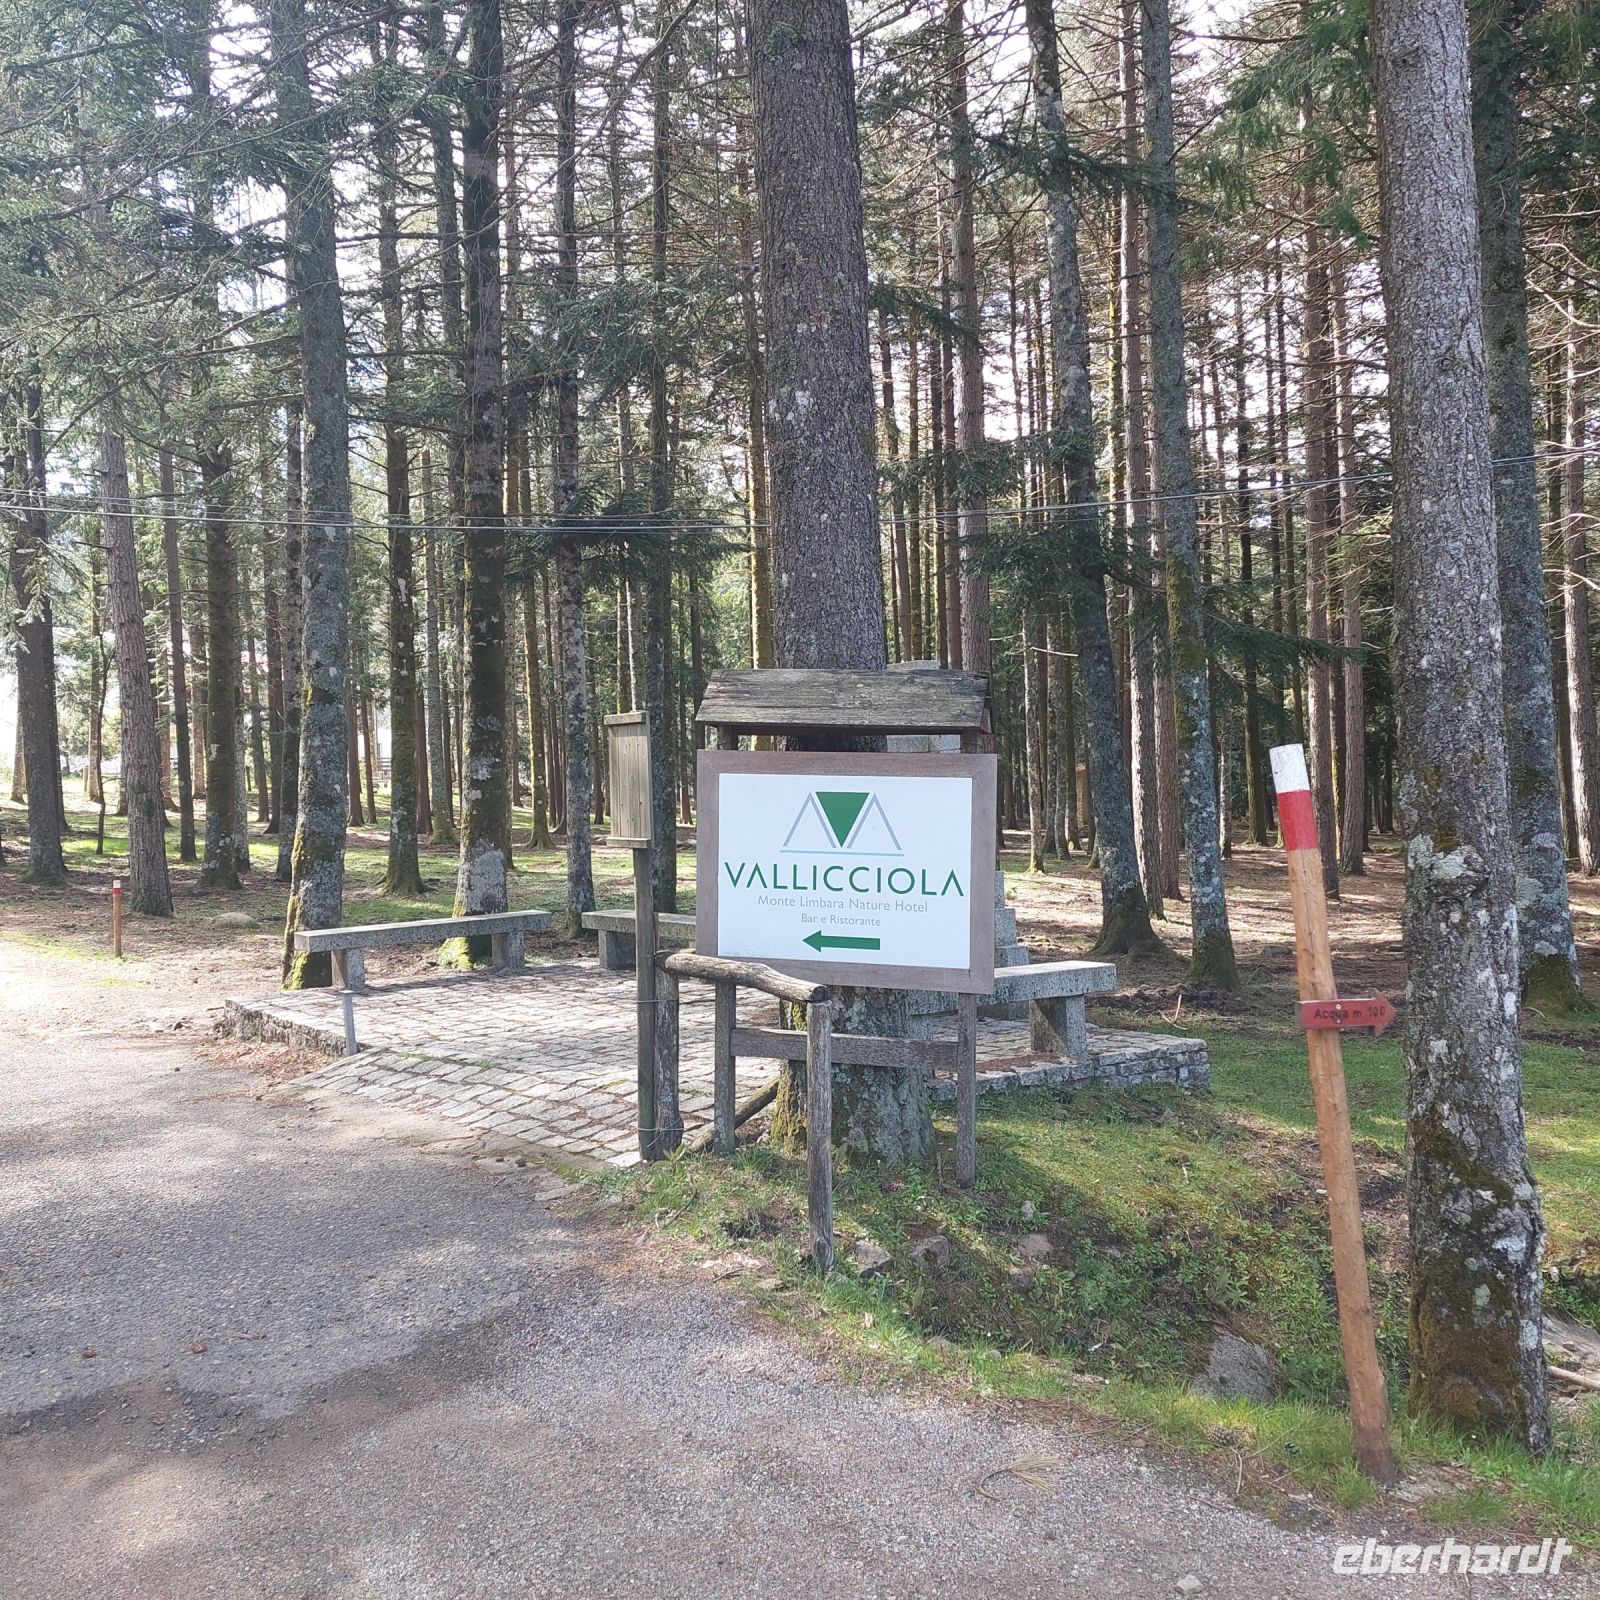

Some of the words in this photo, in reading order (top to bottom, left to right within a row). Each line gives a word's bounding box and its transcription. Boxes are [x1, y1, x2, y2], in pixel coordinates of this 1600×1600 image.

[724, 861, 965, 897] VALLICCIOLA
[758, 895, 796, 907] Monte
[800, 895, 844, 909] Limbara
[849, 898, 891, 911] Nature
[895, 899, 928, 913] Hotel
[801, 913, 818, 924] Bar
[820, 917, 827, 925] e
[830, 914, 881, 927] Ristorante
[1352, 1010, 1362, 1018] m
[1368, 1006, 1386, 1018] 100
